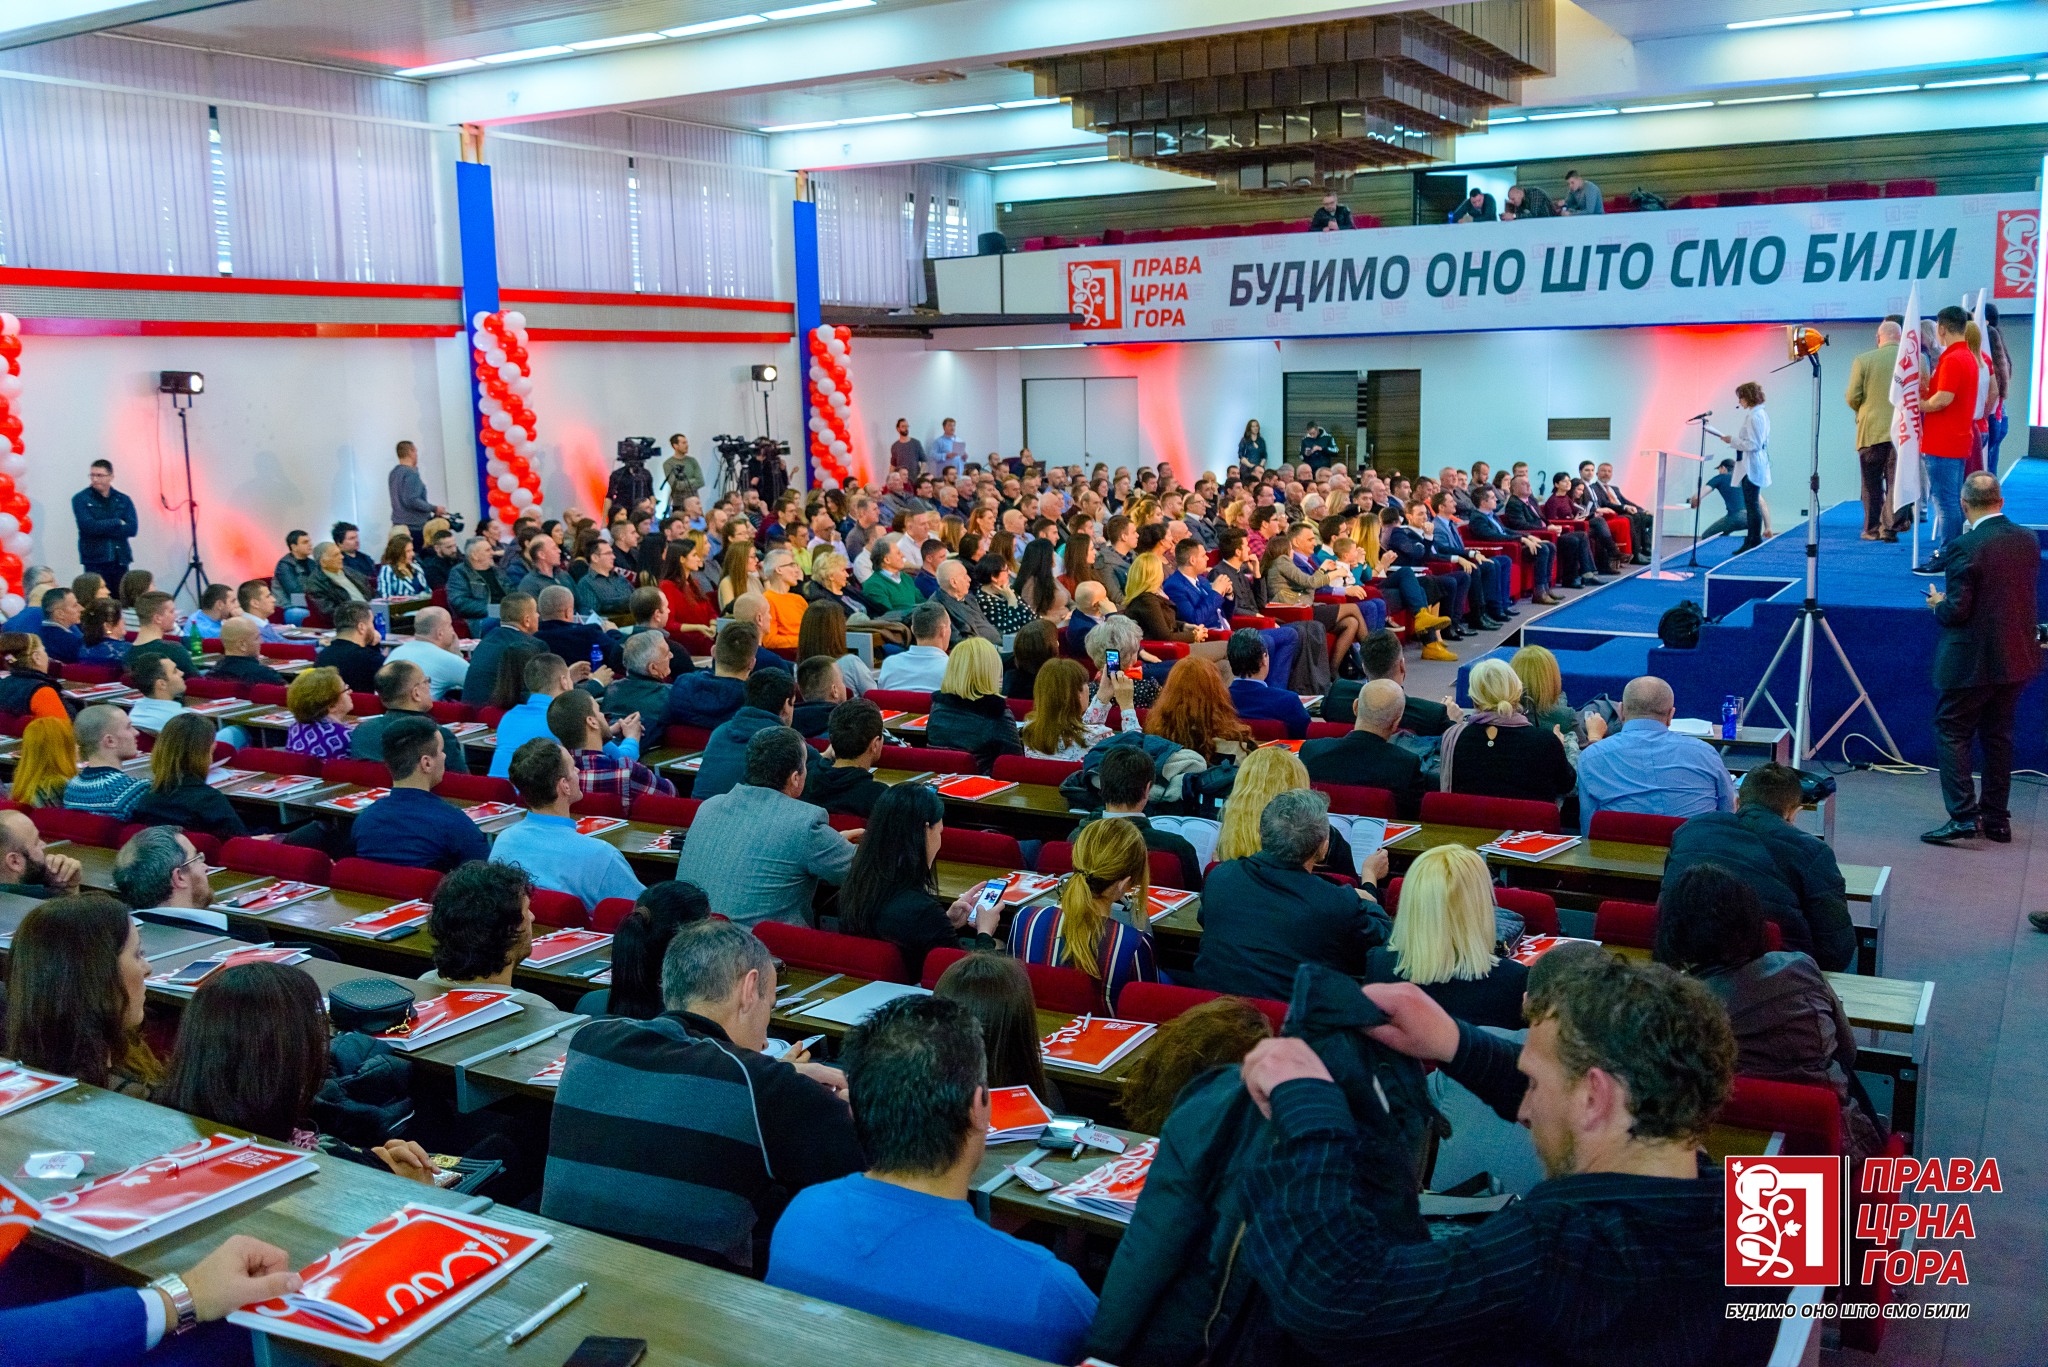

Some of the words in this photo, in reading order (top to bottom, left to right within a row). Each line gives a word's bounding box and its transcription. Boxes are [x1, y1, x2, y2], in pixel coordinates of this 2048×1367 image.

[1132, 256, 1202, 277] ПРАВА
[1230, 255, 1410, 312] БУДИМО
[1426, 248, 1526, 298] ОНО
[1541, 242, 1654, 293] ШТО
[1670, 235, 1786, 288] СМО
[1802, 228, 1958, 283] БИЛИ
[1131, 282, 1189, 306] ЦРНА
[1134, 308, 1186, 328] ГОРА
